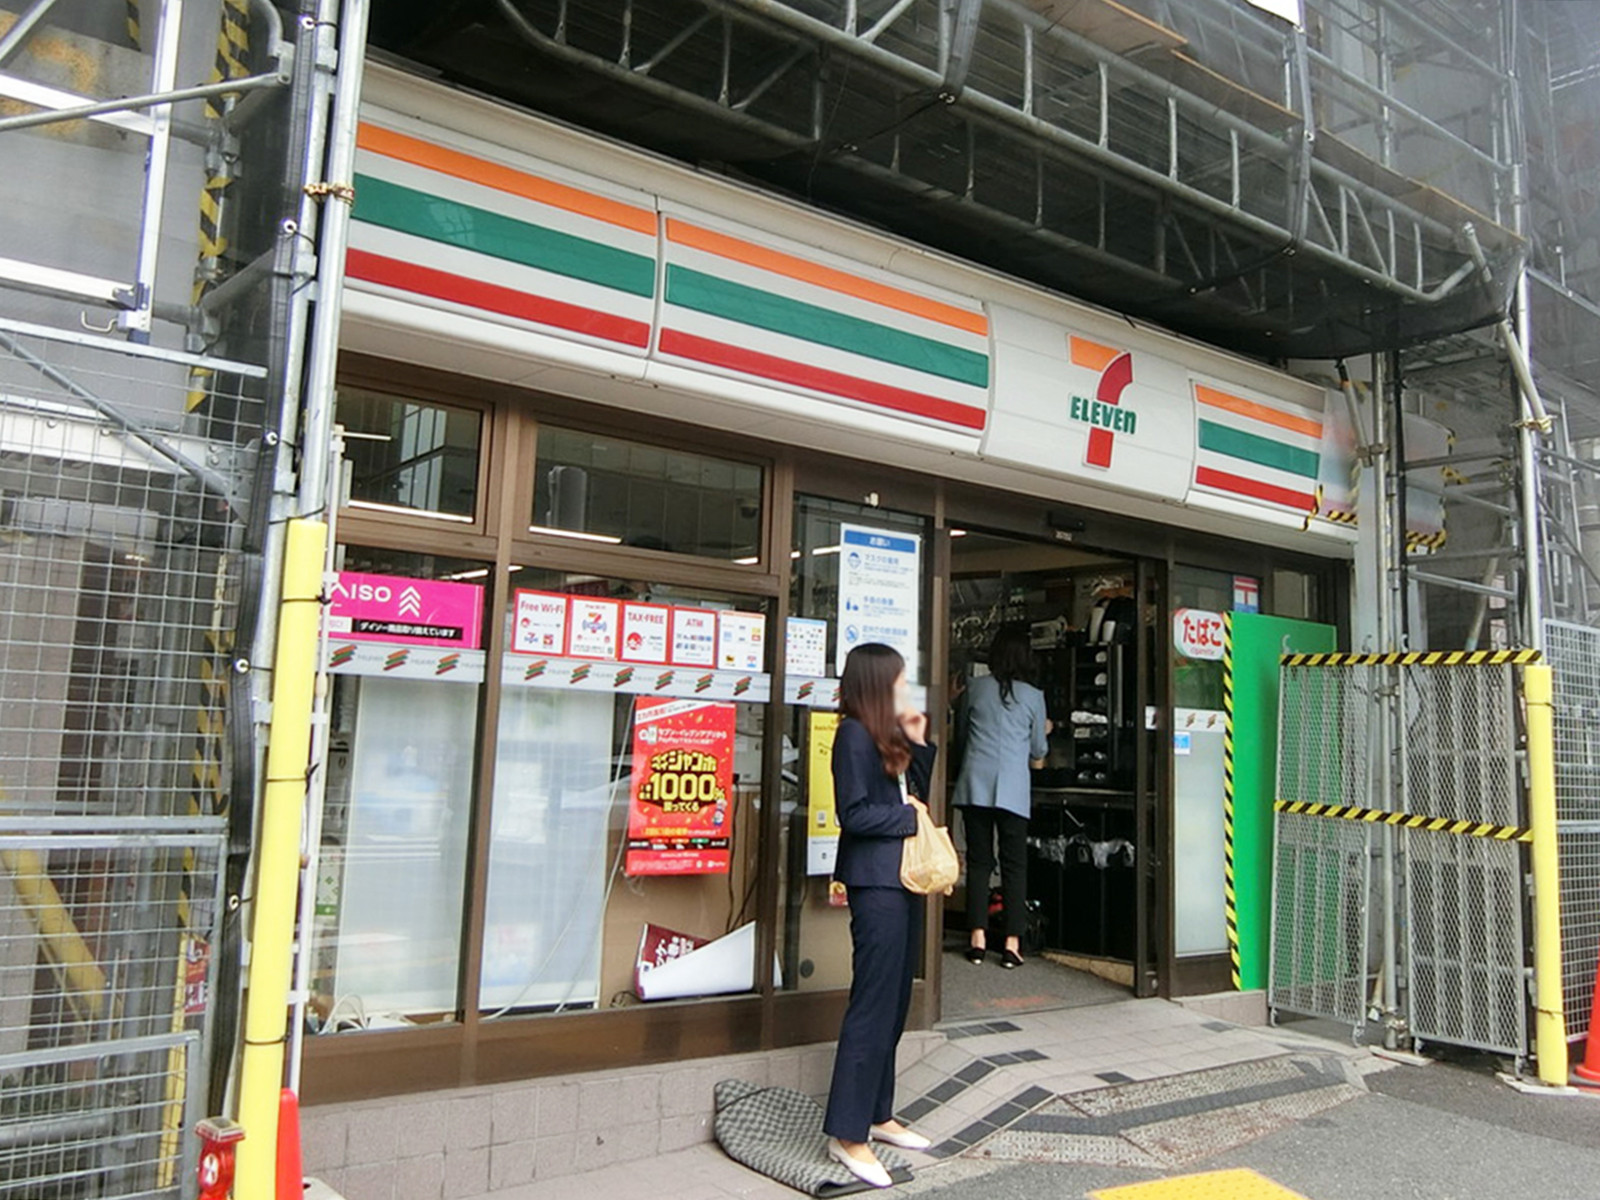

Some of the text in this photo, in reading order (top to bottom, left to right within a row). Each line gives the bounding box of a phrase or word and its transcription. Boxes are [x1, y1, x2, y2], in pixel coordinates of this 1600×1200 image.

[329, 581, 392, 602] AISO
[520, 600, 564, 614] Free Wi-Fi
[685, 618, 704, 628] ATM
[1182, 616, 1222, 647] たばこ
